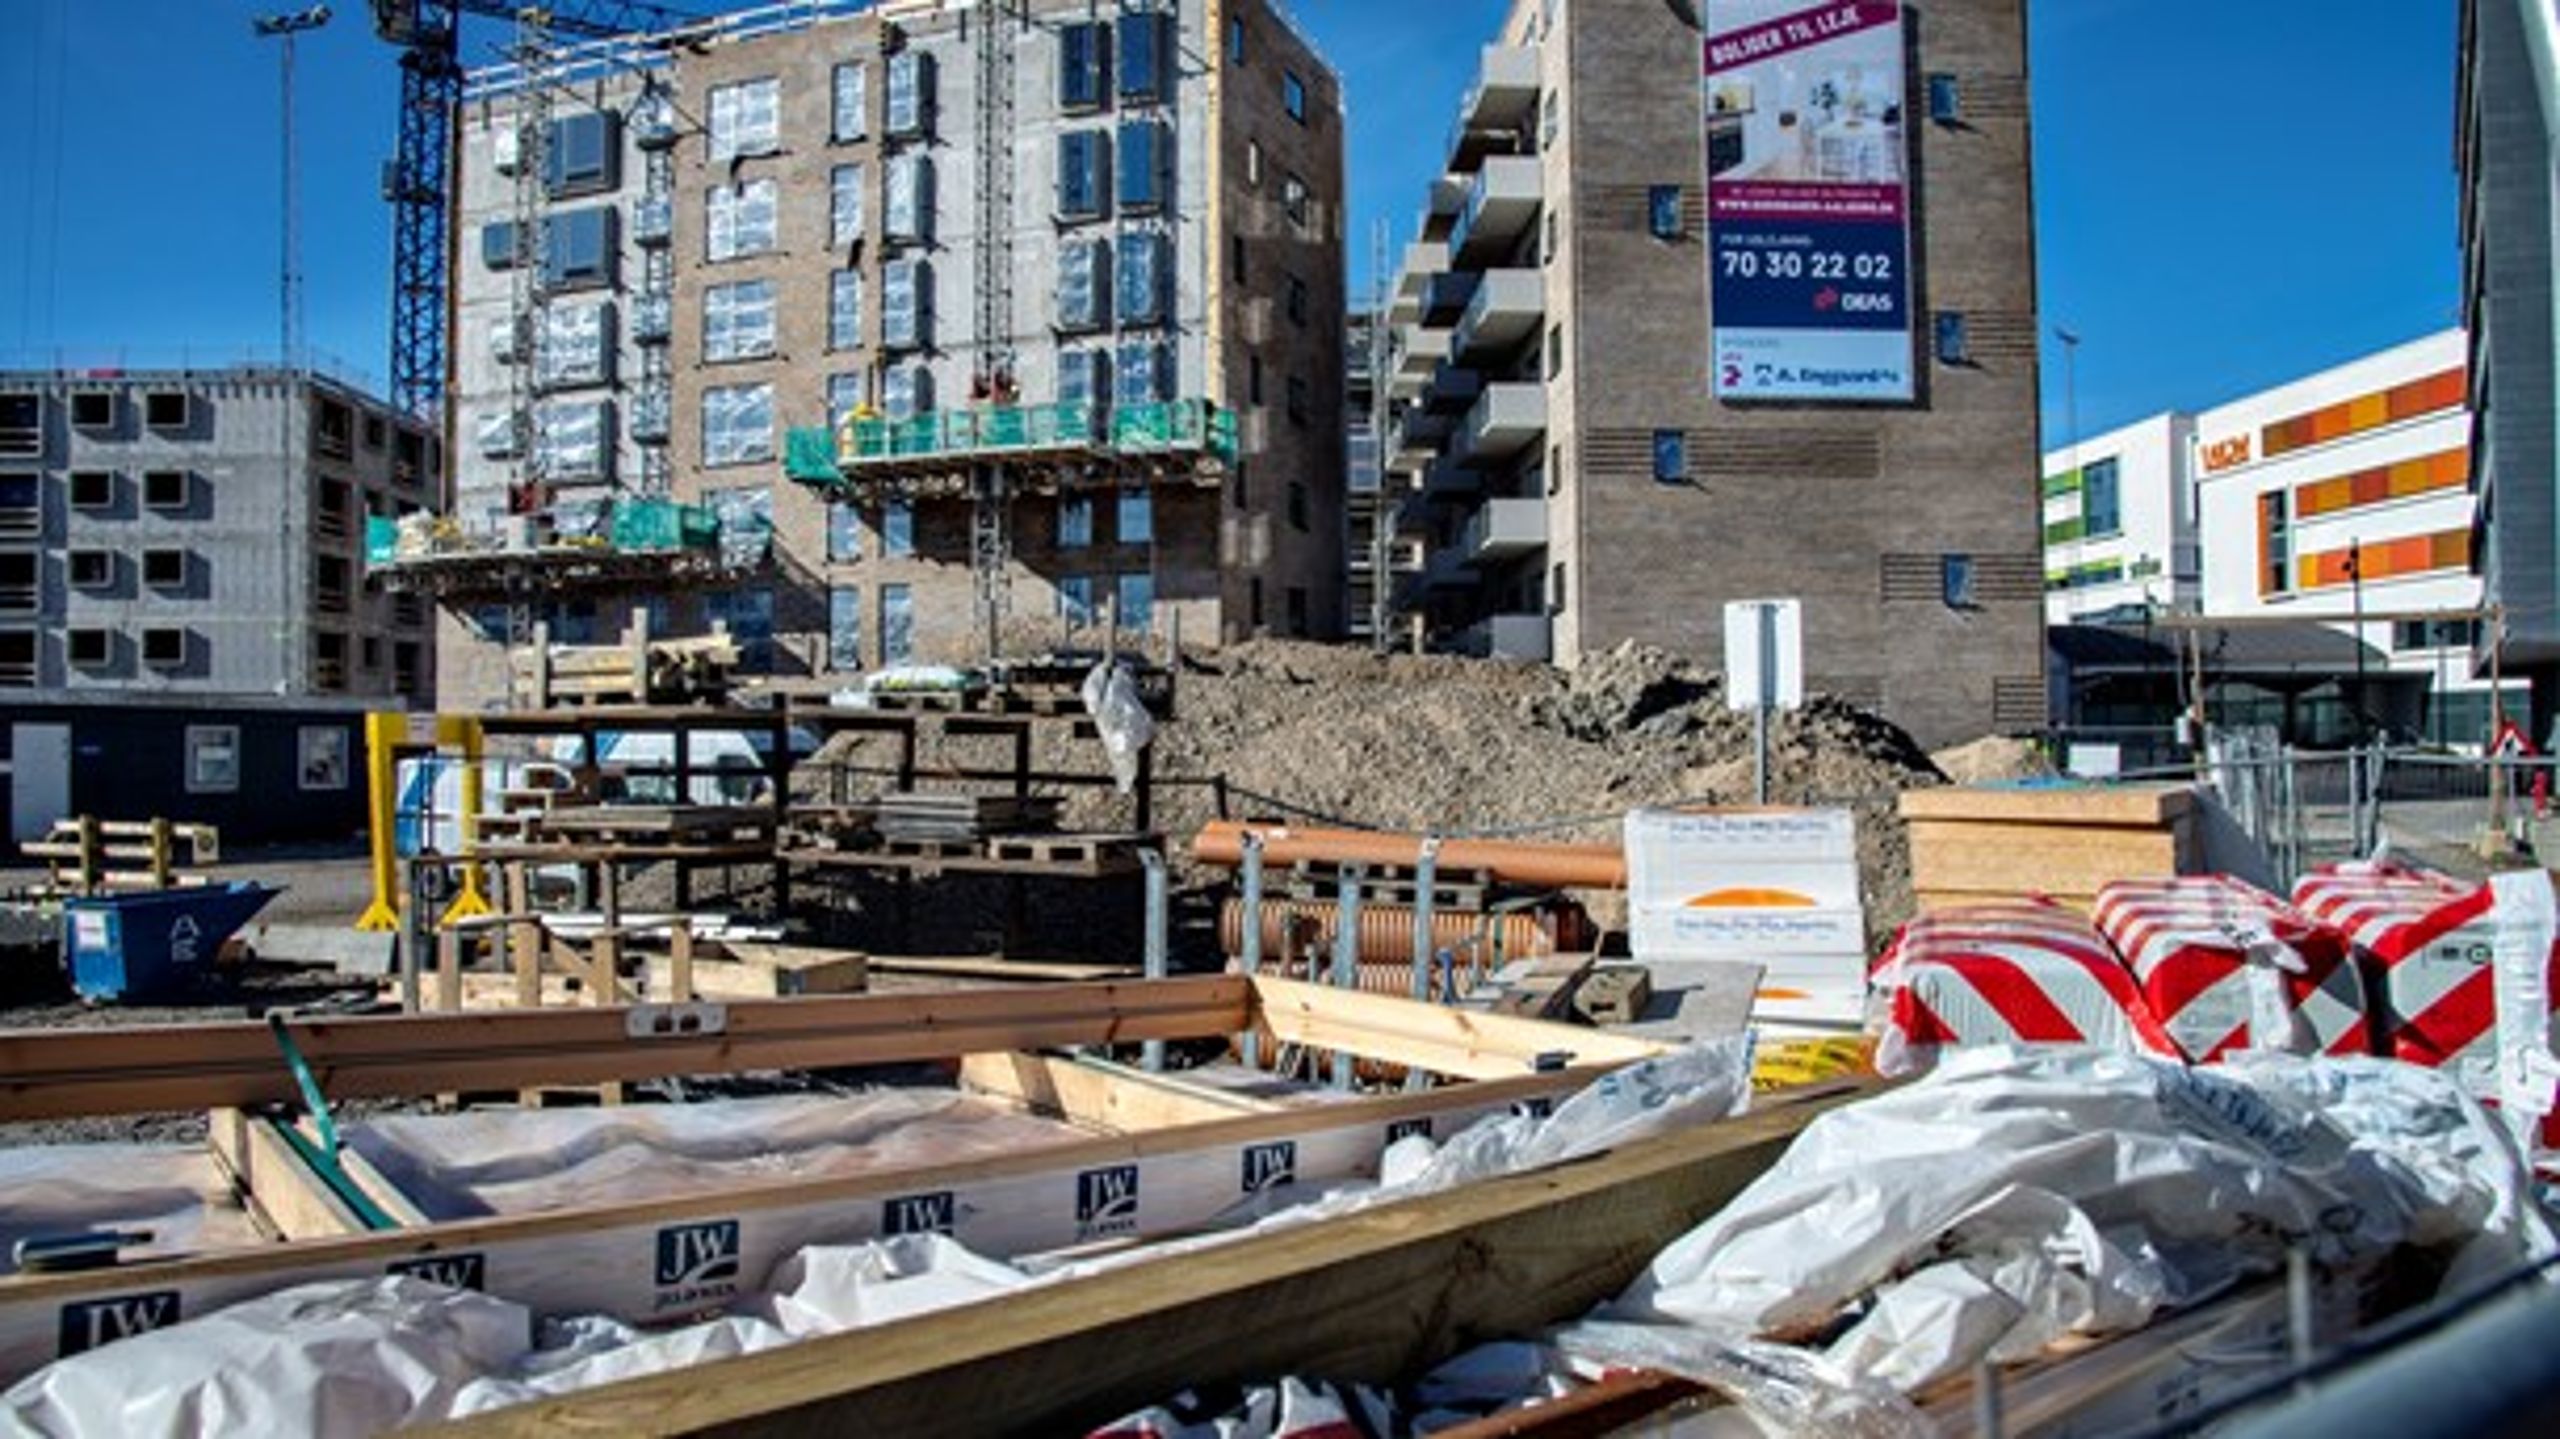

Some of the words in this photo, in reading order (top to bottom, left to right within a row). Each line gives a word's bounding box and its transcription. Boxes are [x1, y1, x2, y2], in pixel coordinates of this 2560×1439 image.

[1721, 251, 1759, 278] 70
[1765, 251, 1802, 278] 30
[1810, 252, 1847, 279] 22
[1854, 253, 1891, 280] 02
[1246, 1146, 1290, 1189] JW
[898, 1194, 947, 1233] JW
[1084, 1169, 1133, 1218] JW
[662, 1224, 732, 1280] JW
[85, 1296, 171, 1347] JW
